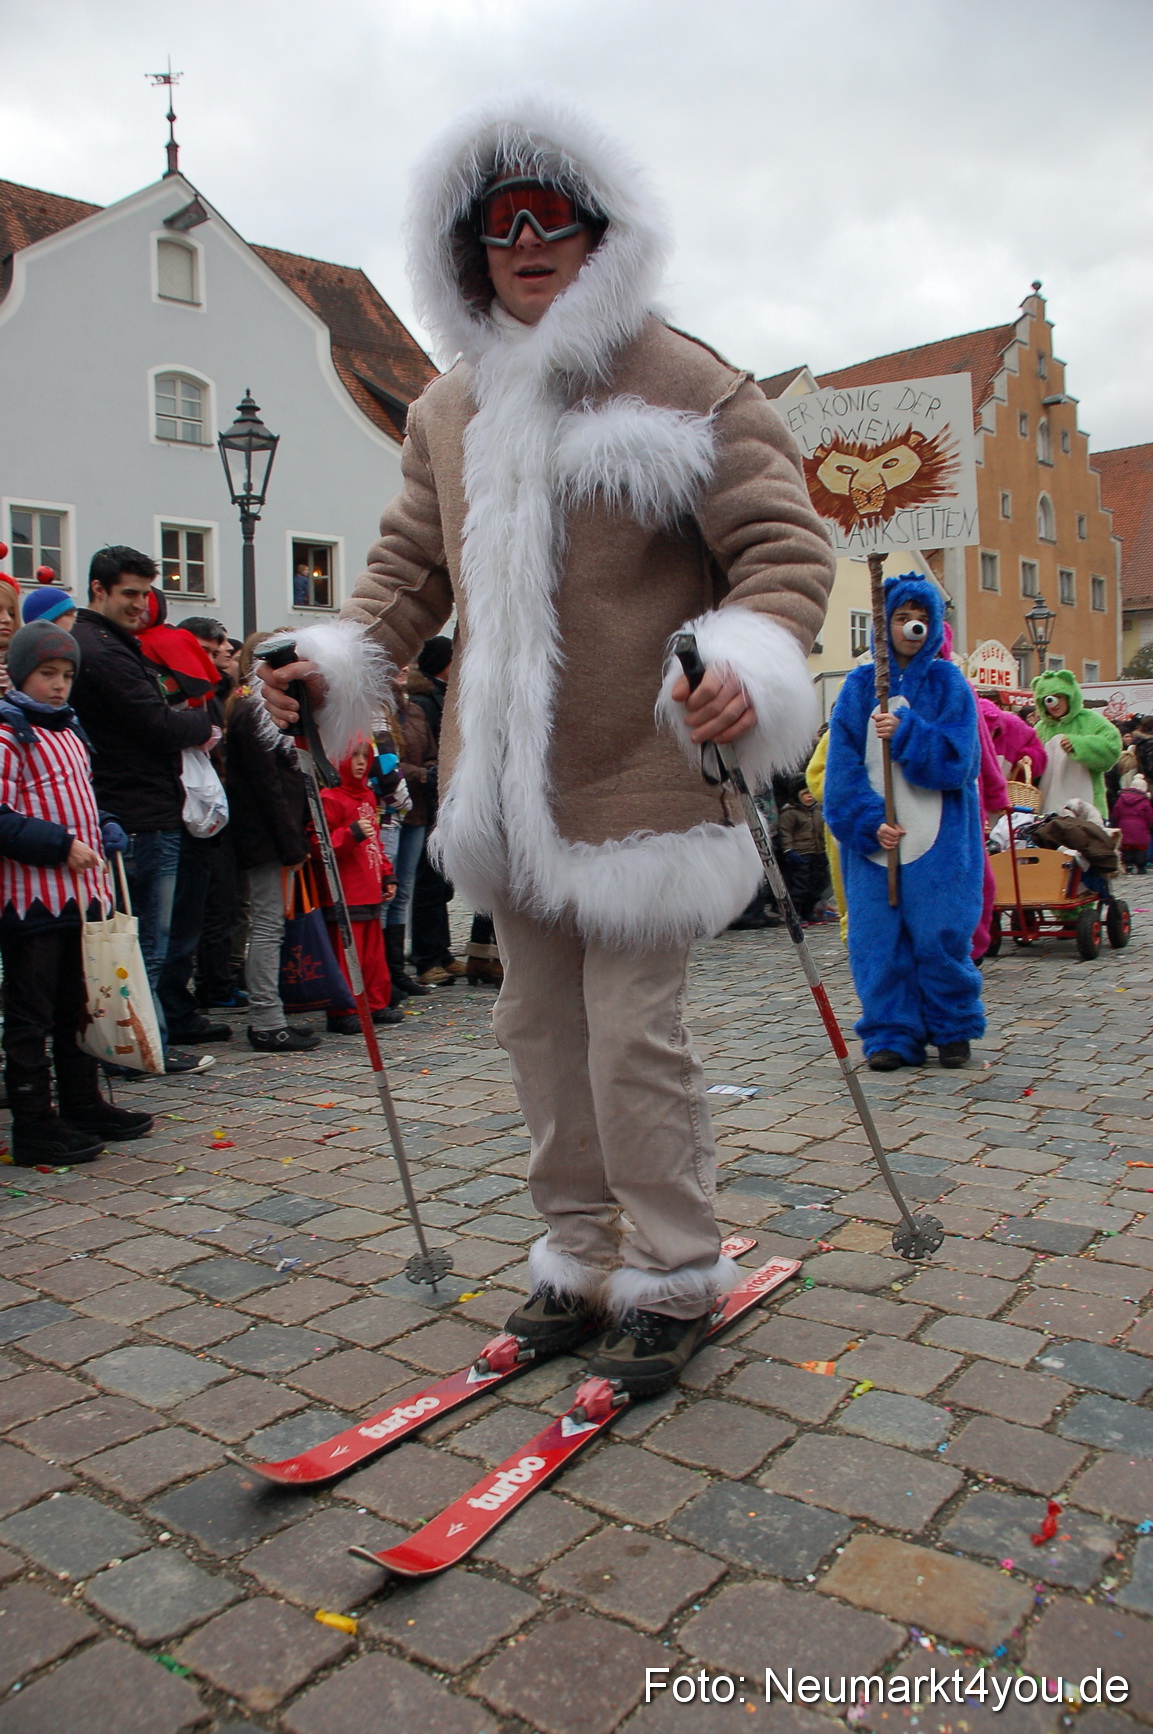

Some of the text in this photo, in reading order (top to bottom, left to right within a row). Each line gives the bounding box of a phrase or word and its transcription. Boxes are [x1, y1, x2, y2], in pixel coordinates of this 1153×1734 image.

[784, 387, 942, 432] ER KÖNIG DER
[802, 418, 901, 452] LÖWEN
[1008, 694, 1036, 706] POPC
[746, 1265, 790, 1292] racing
[358, 1397, 440, 1439] turbo
[466, 1456, 546, 1511] turbo
